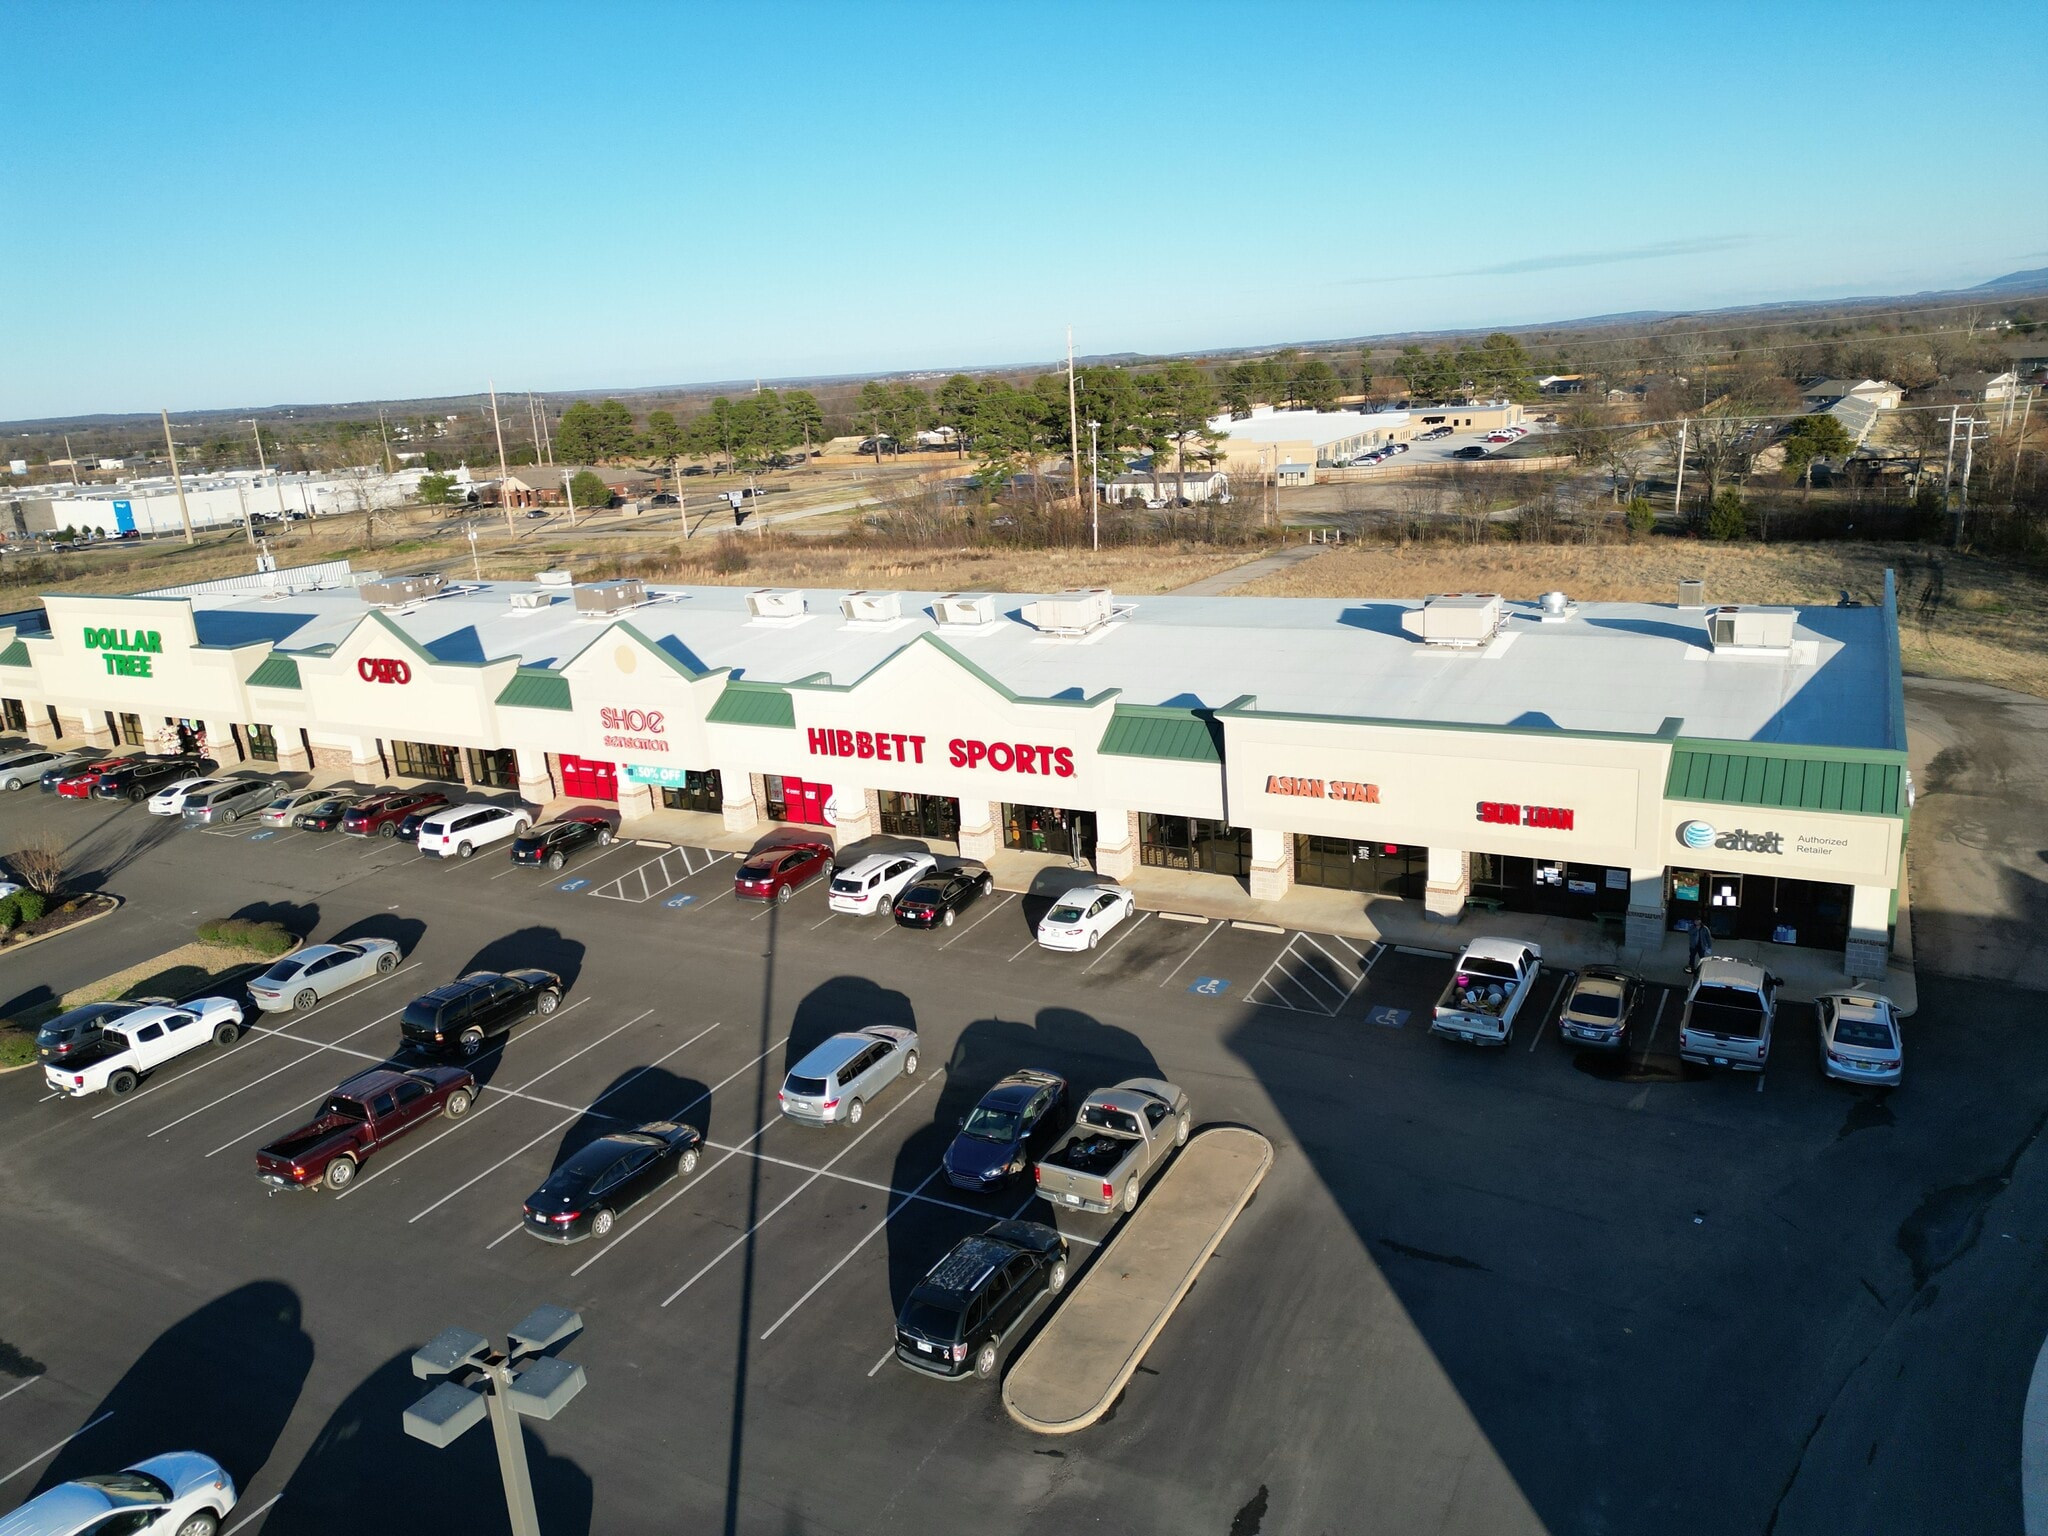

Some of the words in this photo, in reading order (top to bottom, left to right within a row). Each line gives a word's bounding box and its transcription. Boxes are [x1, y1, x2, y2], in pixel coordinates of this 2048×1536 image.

[83, 627, 163, 654] DOLLAR
[102, 653, 153, 678] TREE
[357, 657, 412, 685] CATO
[807, 727, 926, 764] HIBBETT
[948, 738, 1075, 778] SPORTS
[660, 769, 681, 781] OFF
[1265, 775, 1325, 799] ASIAN
[1328, 780, 1380, 804] STAR
[1476, 801, 1521, 826] SUN
[1522, 805, 1574, 831] LOAN
[1796, 845, 1833, 856] Retailer
[1797, 834, 1849, 847] Authorized
